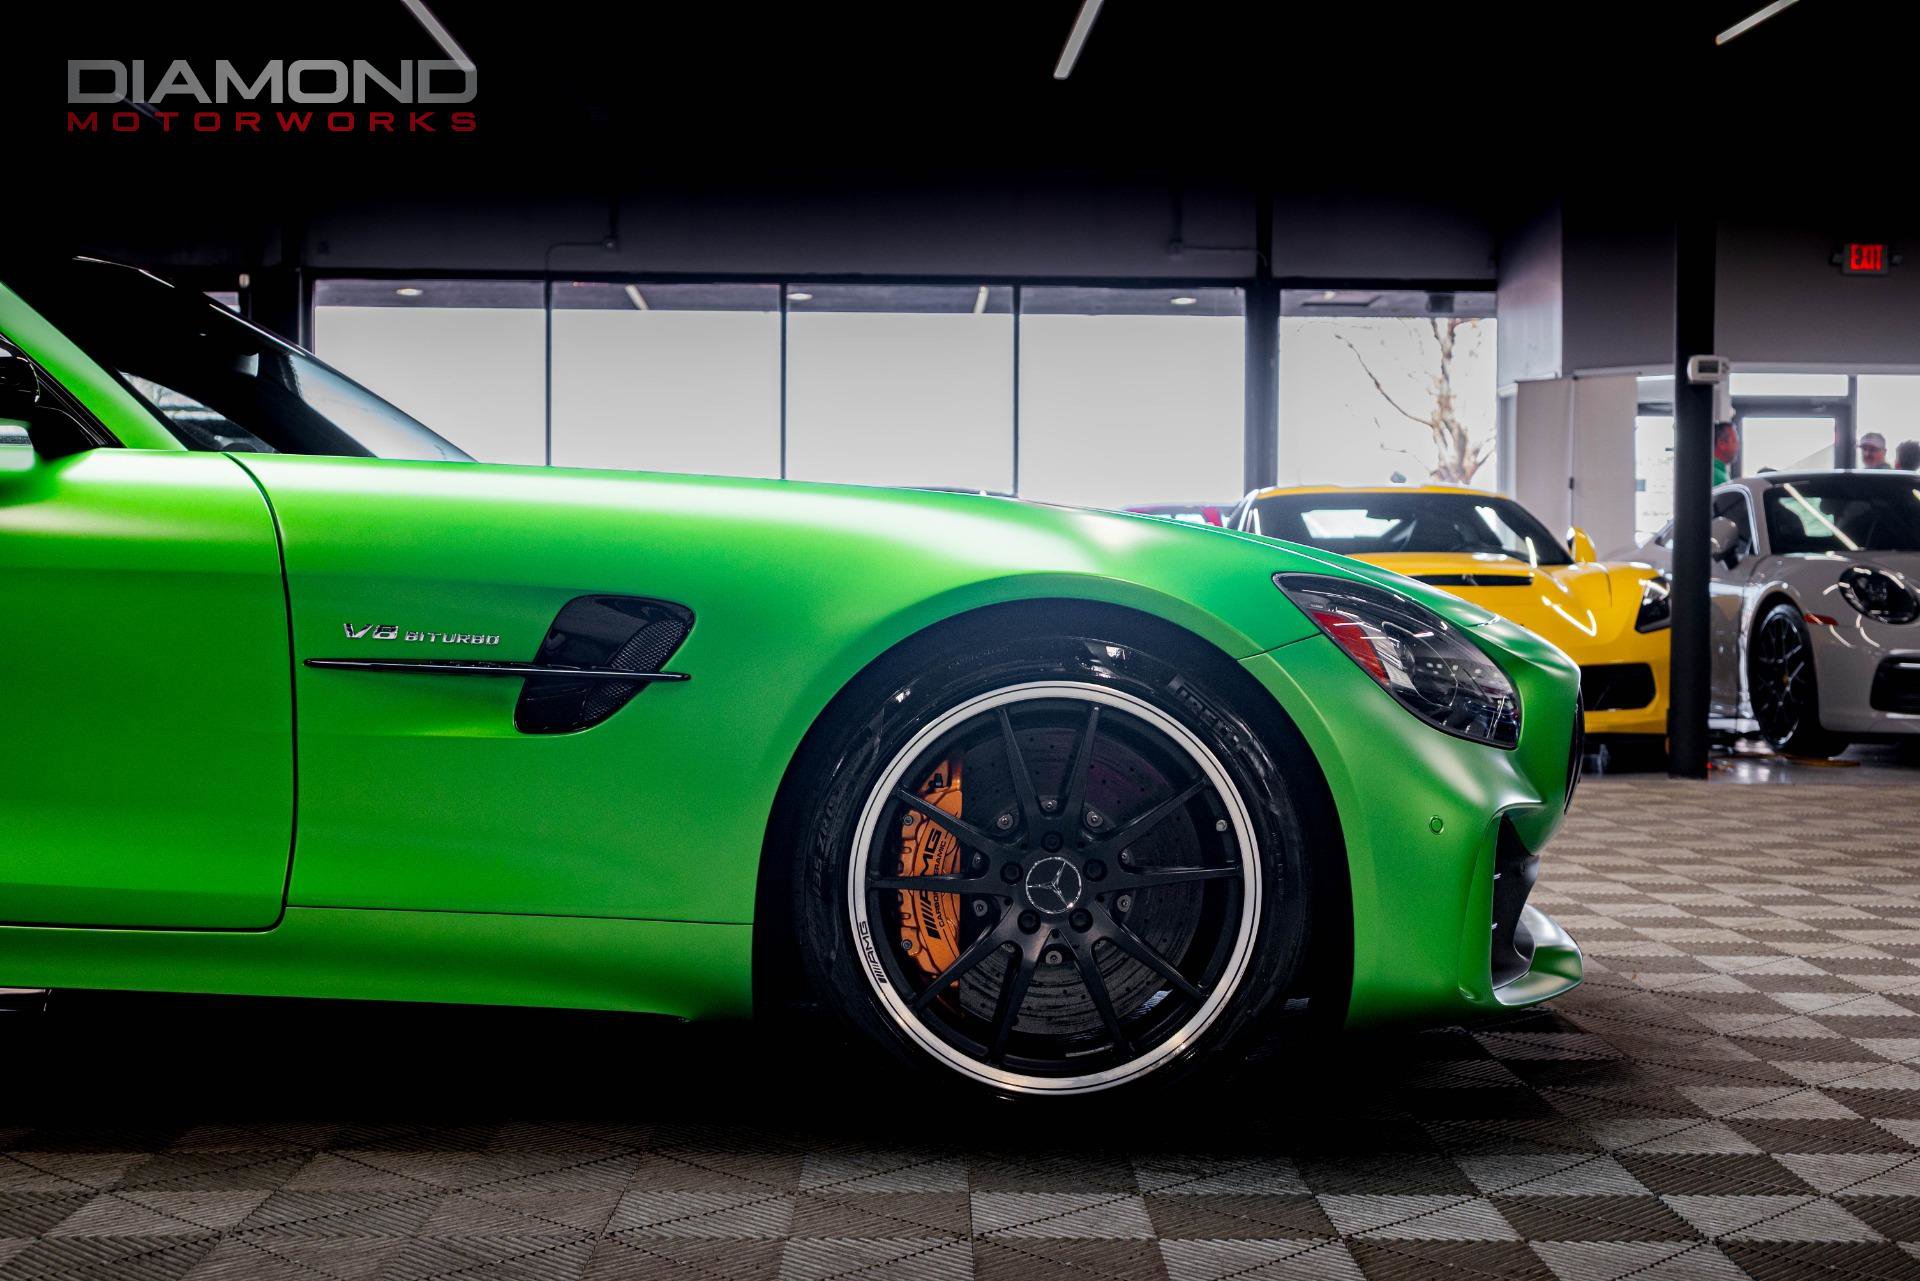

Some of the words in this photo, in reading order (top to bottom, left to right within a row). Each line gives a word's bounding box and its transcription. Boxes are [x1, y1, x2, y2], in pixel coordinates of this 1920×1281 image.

[1850, 243, 1883, 271] EXIT
[343, 623, 399, 639] V8
[404, 630, 500, 645] BITURBO
[934, 840, 946, 875] ERAMIC
[933, 892, 944, 928] CARBO
